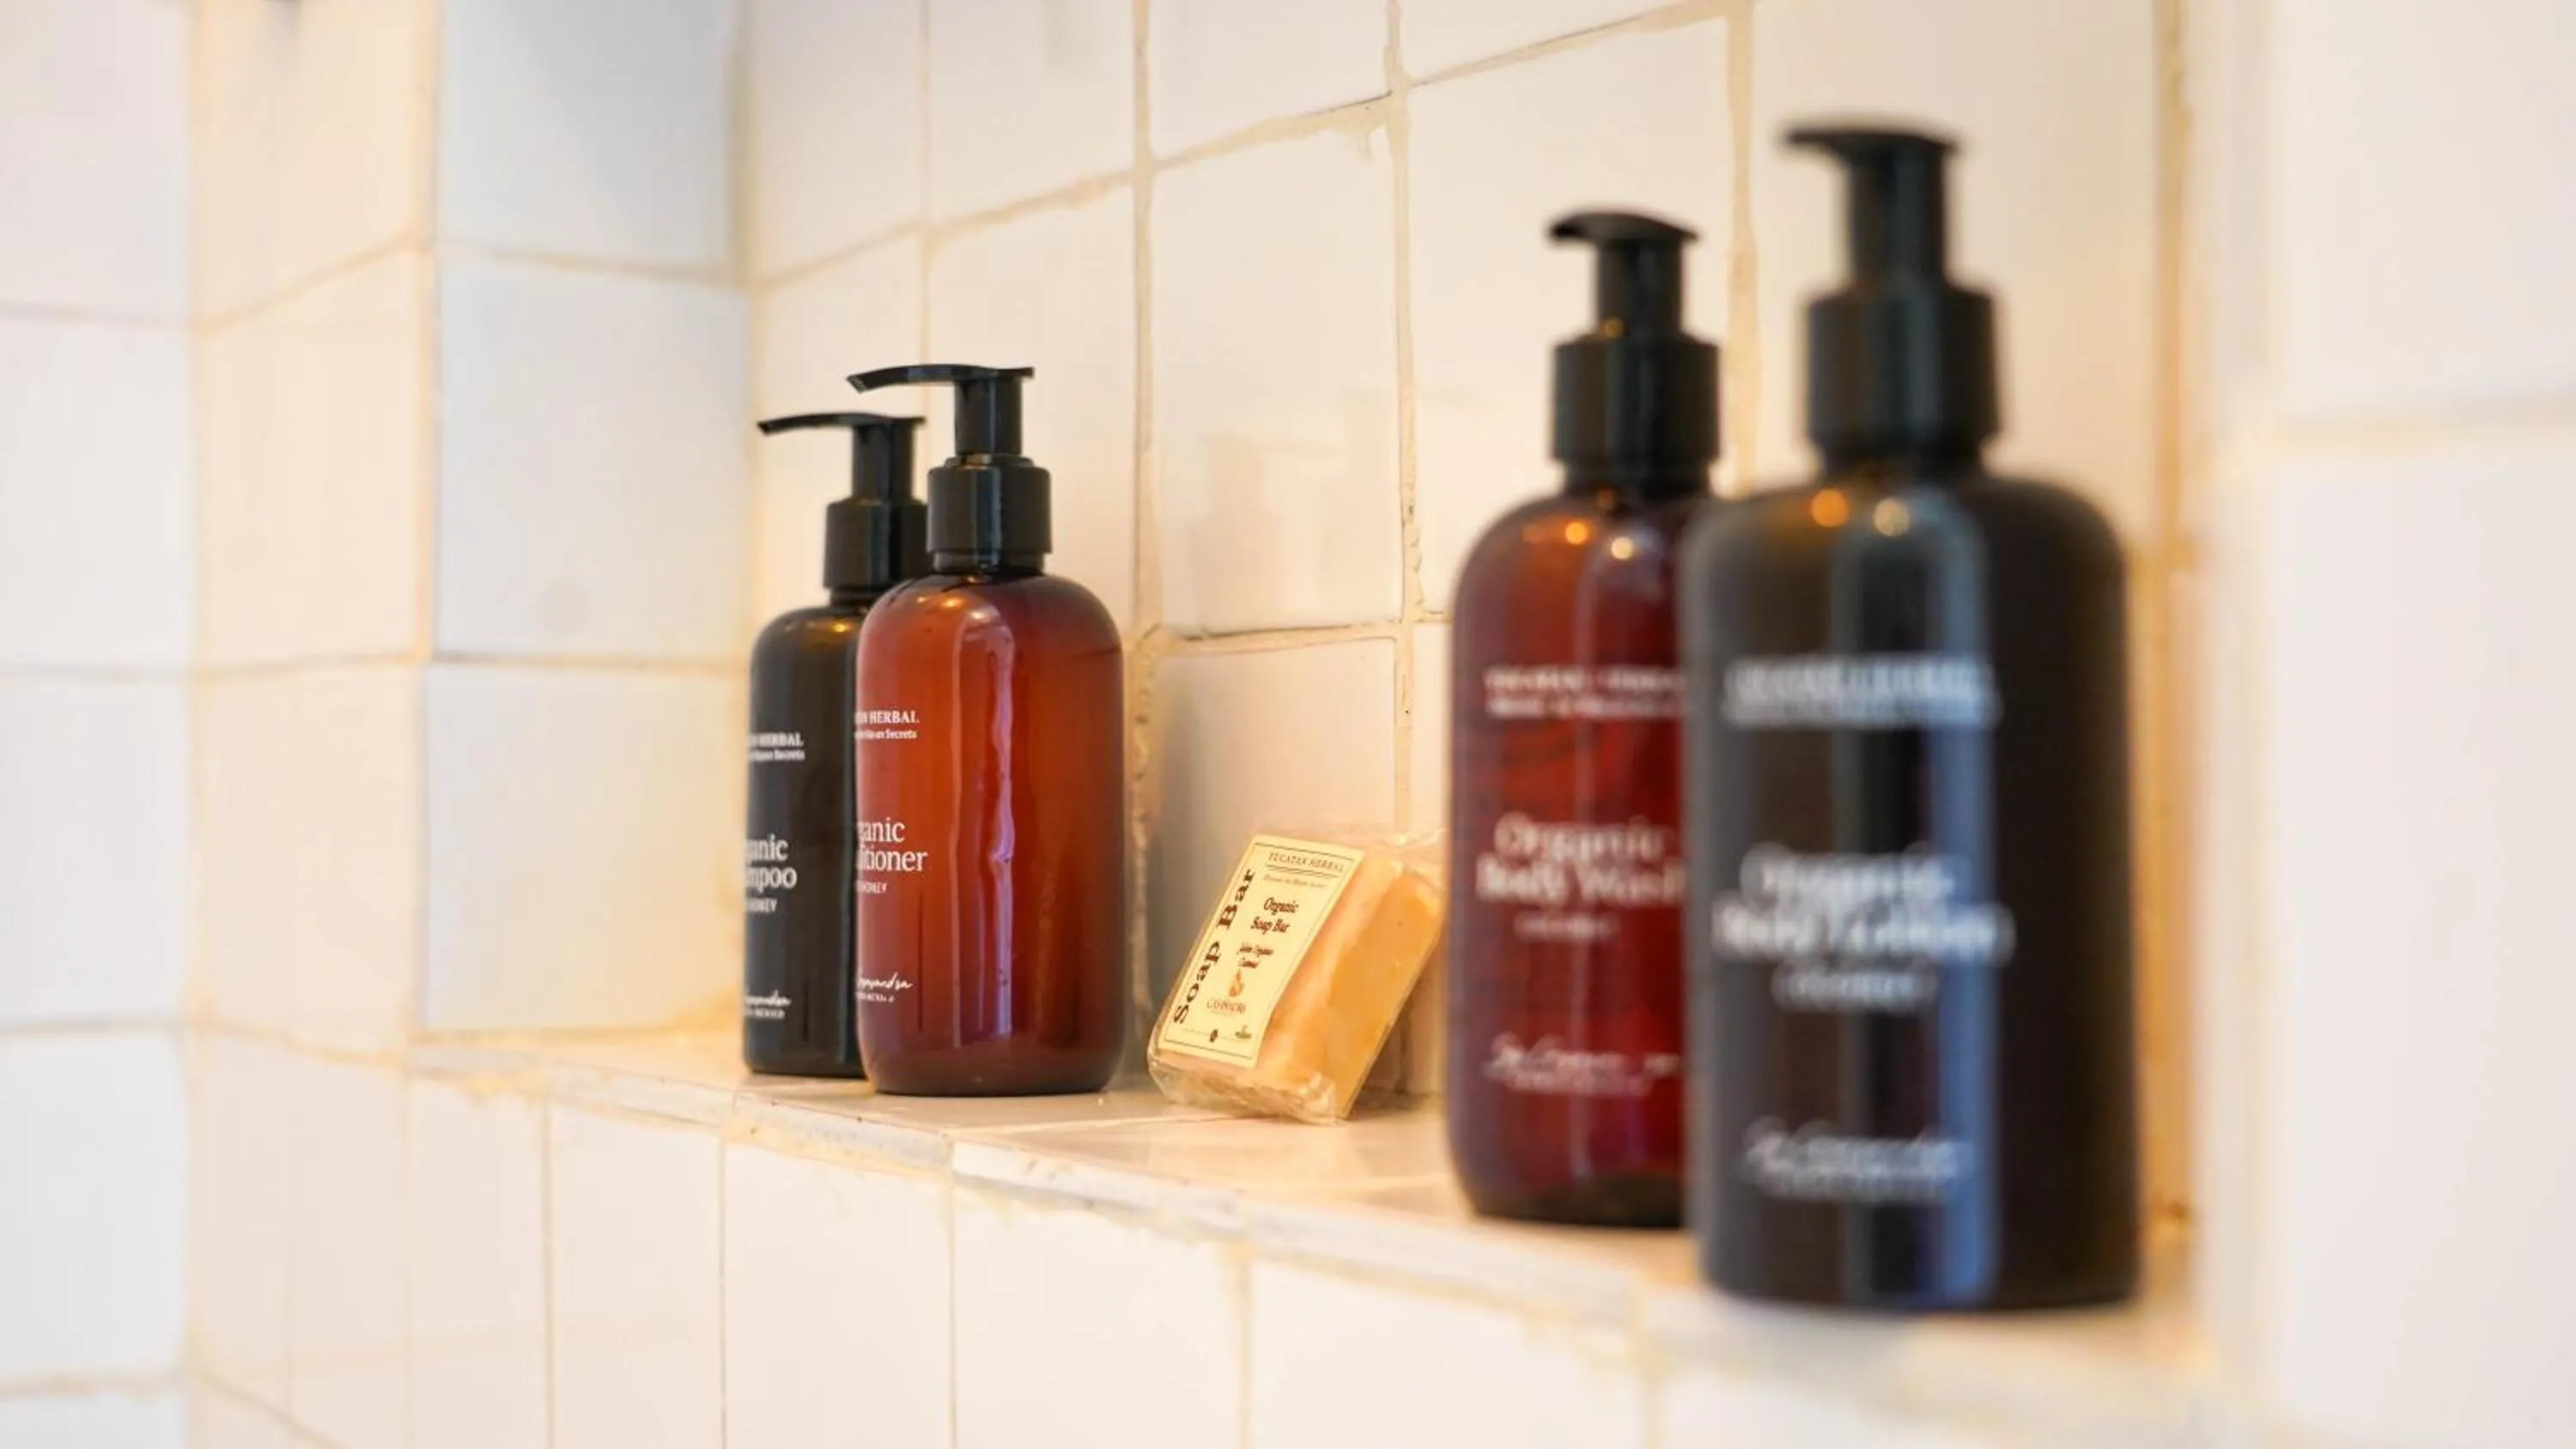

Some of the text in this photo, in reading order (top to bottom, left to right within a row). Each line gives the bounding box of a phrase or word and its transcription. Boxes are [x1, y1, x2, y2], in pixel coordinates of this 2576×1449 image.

[870, 710, 920, 724] HERBAL
[1173, 941, 1221, 1024] Soap
[1217, 869, 1255, 930] Bar
